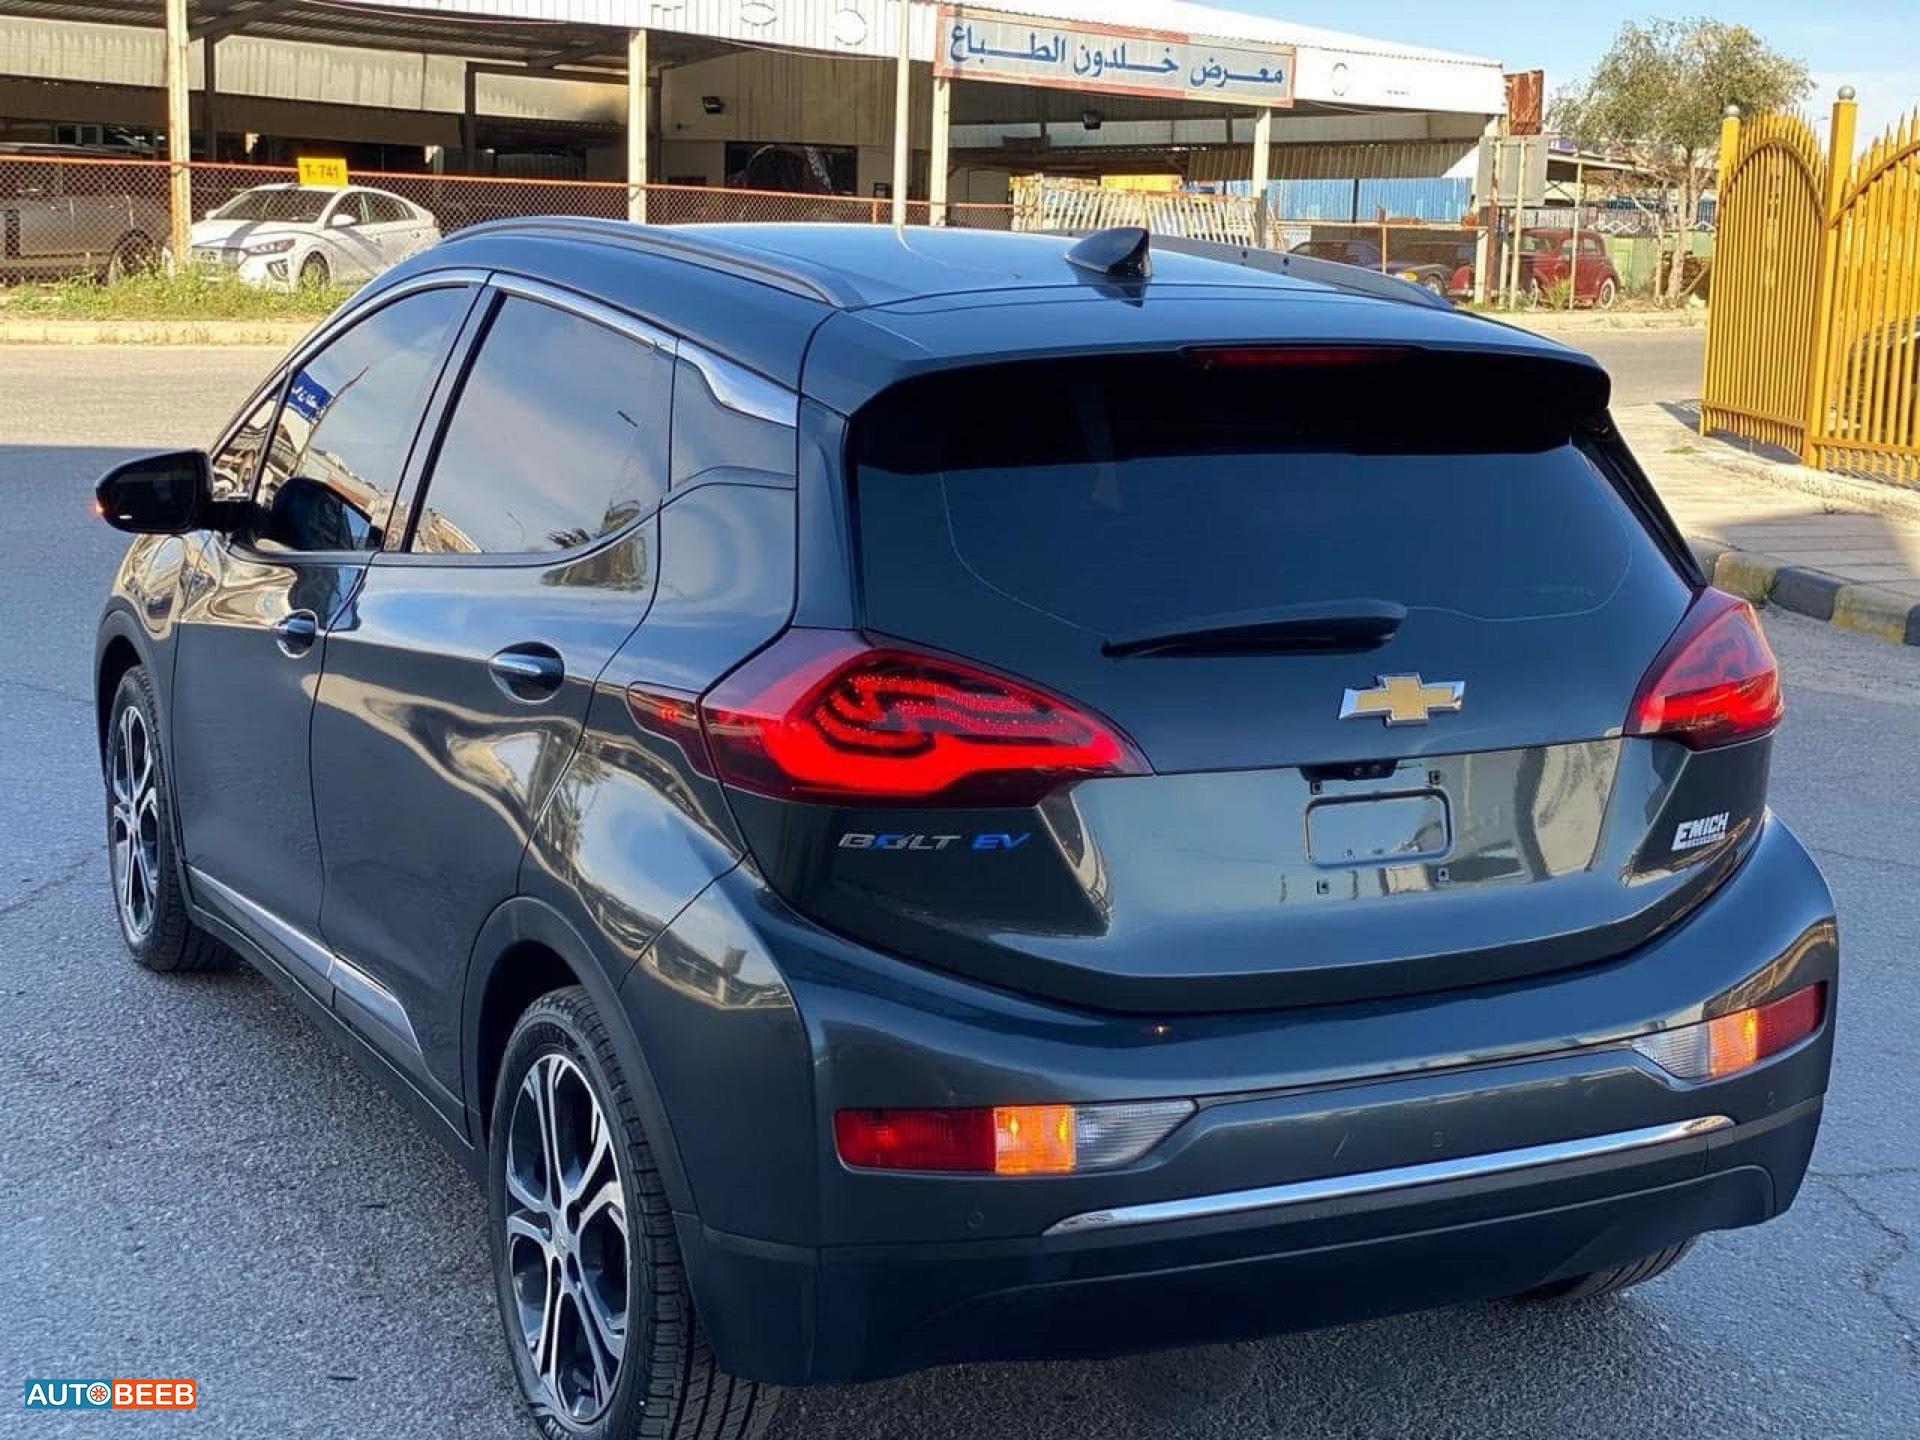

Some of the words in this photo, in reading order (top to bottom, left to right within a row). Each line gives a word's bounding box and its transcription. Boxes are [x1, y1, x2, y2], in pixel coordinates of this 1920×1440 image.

[950, 24, 1065, 63] الطباع
[1073, 44, 1178, 76] خلدون
[1190, 56, 1283, 87] معرض
[838, 833, 961, 850] BOLT
[971, 832, 1032, 849] EV
